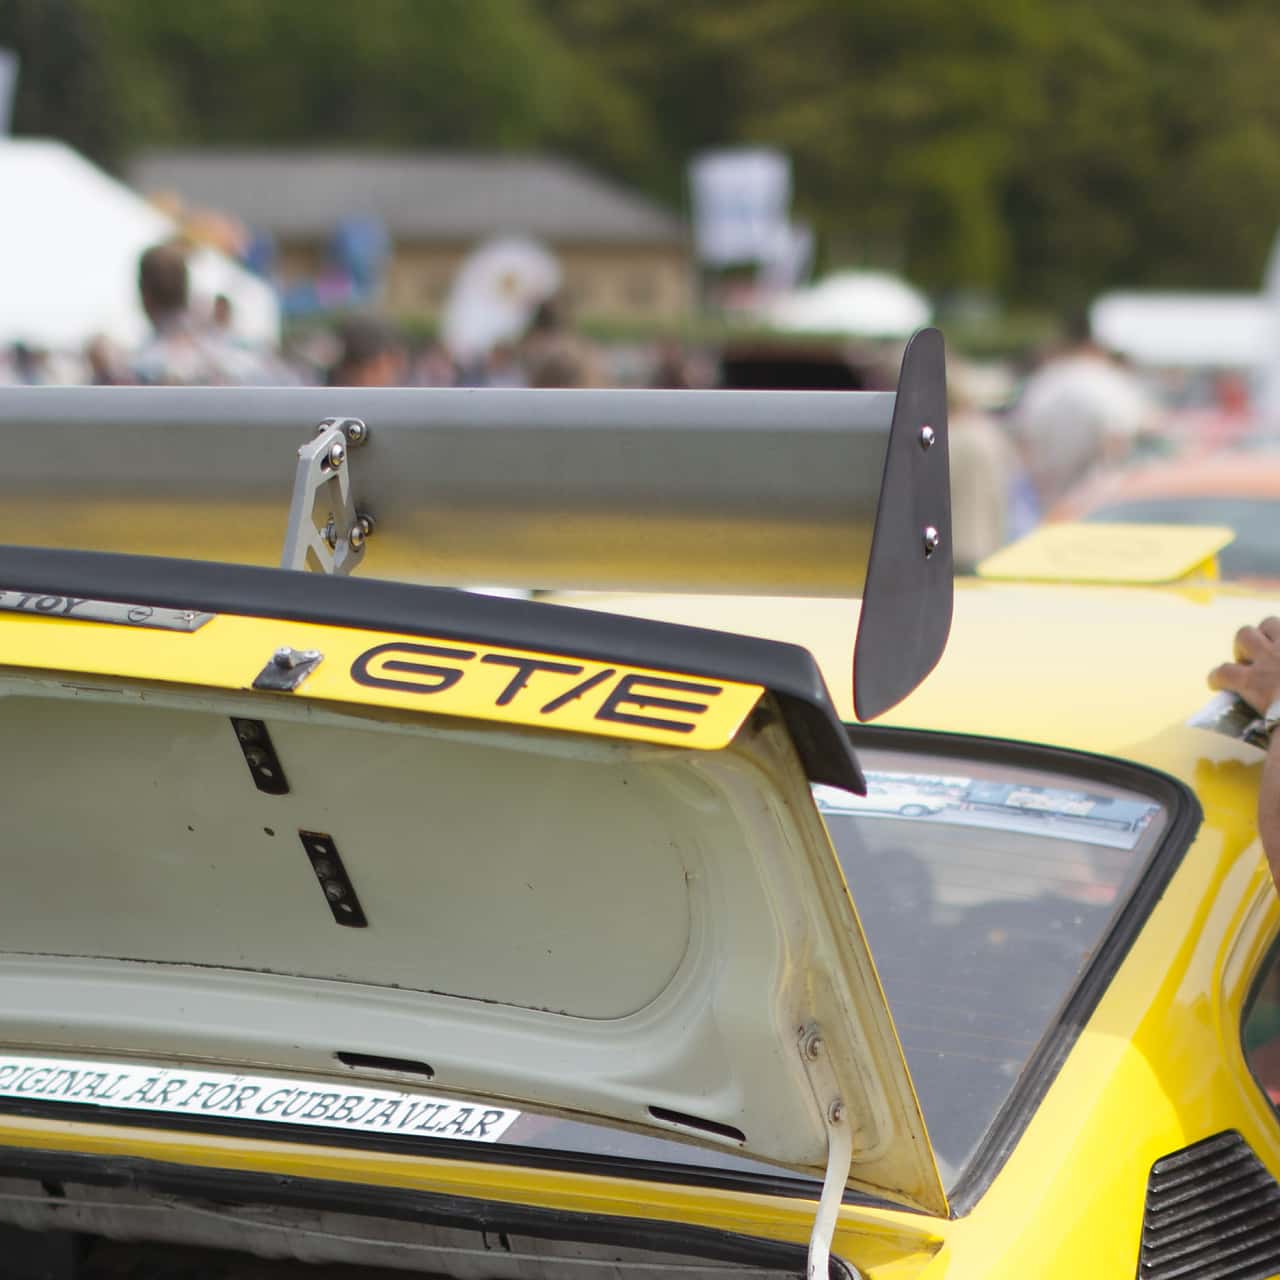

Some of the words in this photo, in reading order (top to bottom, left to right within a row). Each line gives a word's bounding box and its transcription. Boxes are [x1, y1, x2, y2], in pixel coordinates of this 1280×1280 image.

[13, 592, 86, 616] TOY
[350, 642, 723, 734] GT/E
[125, 1069, 182, 1104] ÄR
[184, 1074, 252, 1112] FÖR
[255, 1087, 504, 1138] GUBBJÄVLAR
